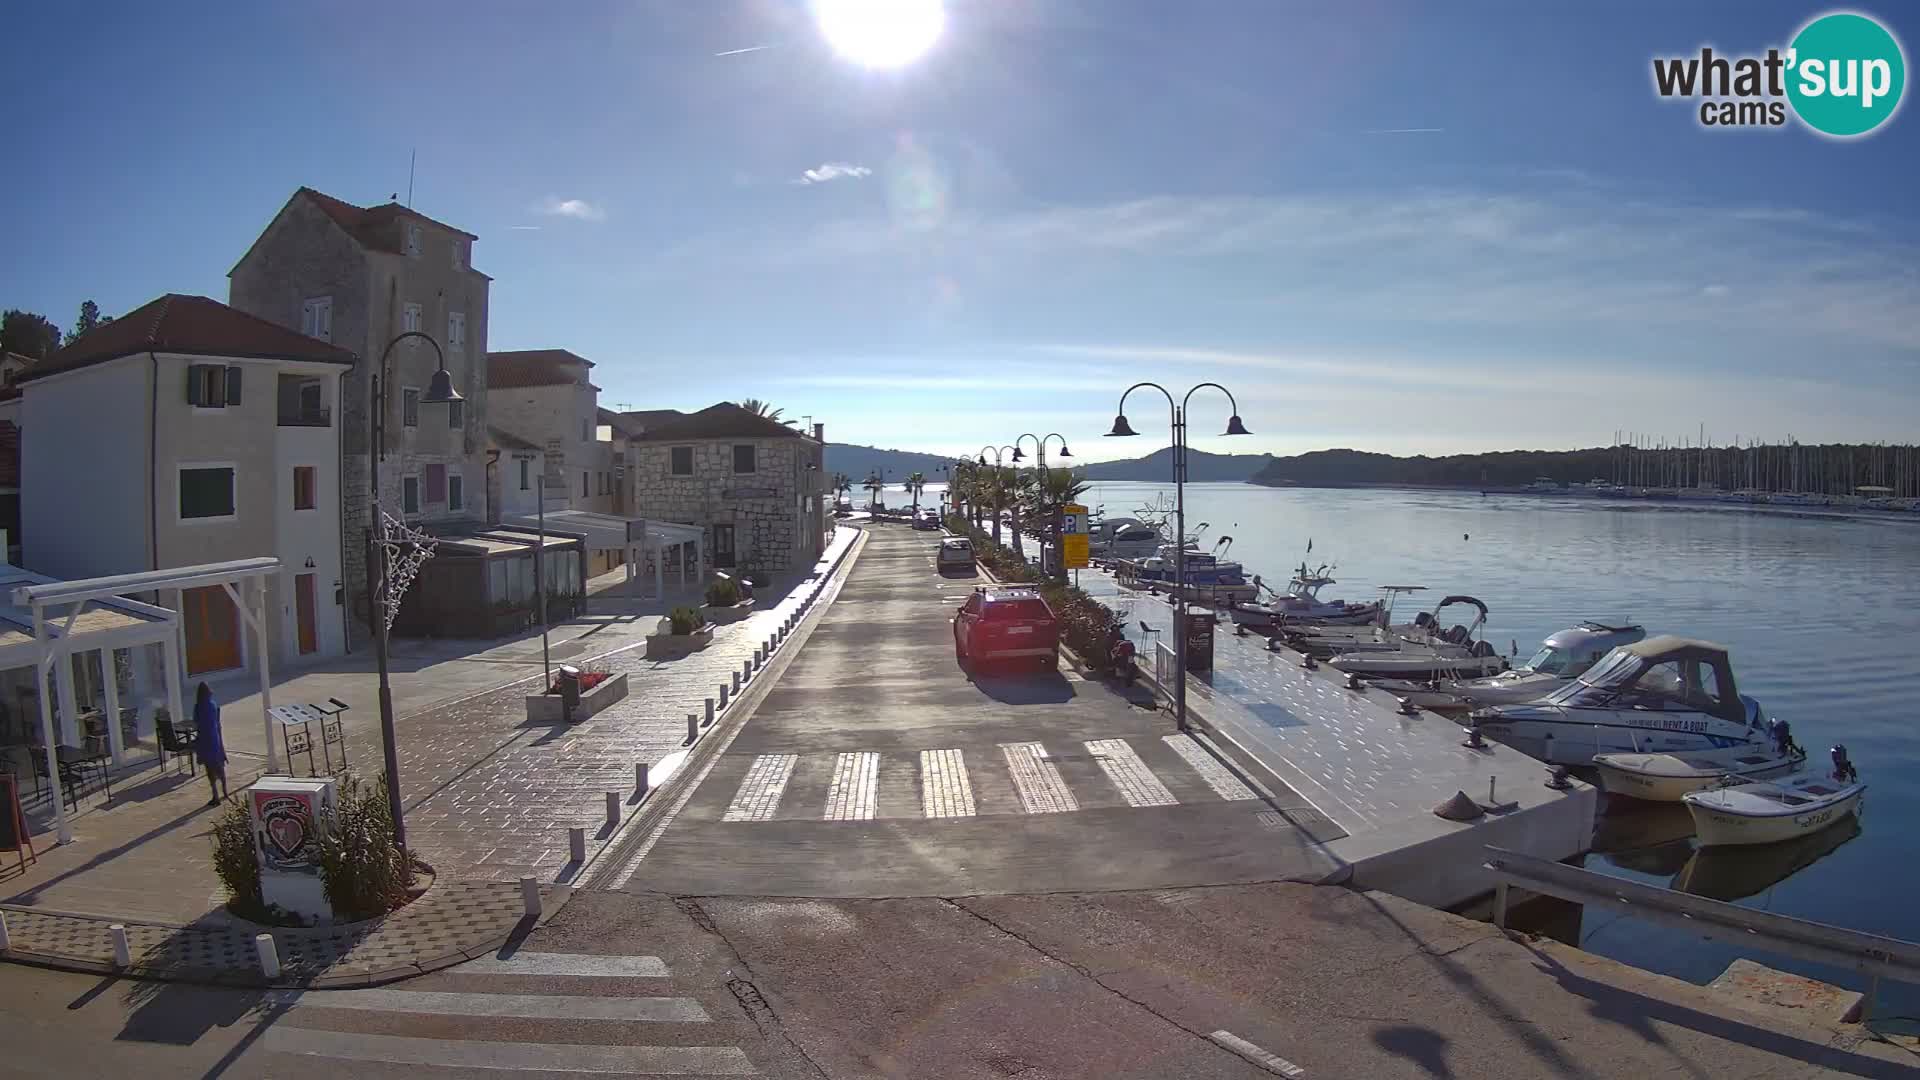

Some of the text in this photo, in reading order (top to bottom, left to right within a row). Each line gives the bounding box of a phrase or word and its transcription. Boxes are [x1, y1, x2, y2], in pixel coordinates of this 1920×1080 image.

[1065, 515, 1076, 532] P
[1663, 720, 1682, 730] RENT
[1690, 721, 1709, 732] BOAT
